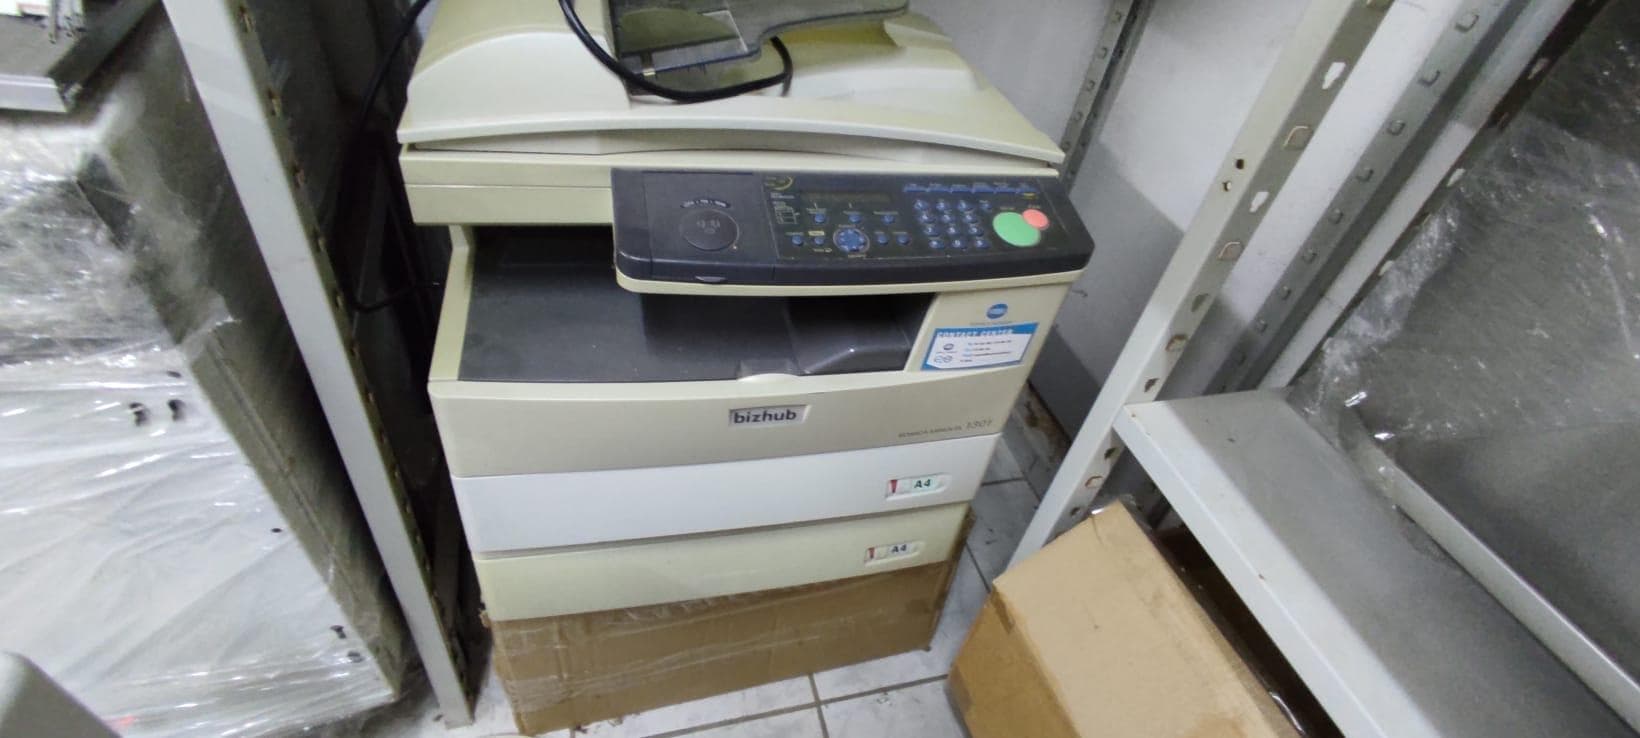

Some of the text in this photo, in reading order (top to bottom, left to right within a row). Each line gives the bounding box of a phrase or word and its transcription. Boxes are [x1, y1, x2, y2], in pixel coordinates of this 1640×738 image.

[733, 409, 797, 424] bizhub
[914, 479, 931, 488] A4
[891, 544, 907, 553] A4
